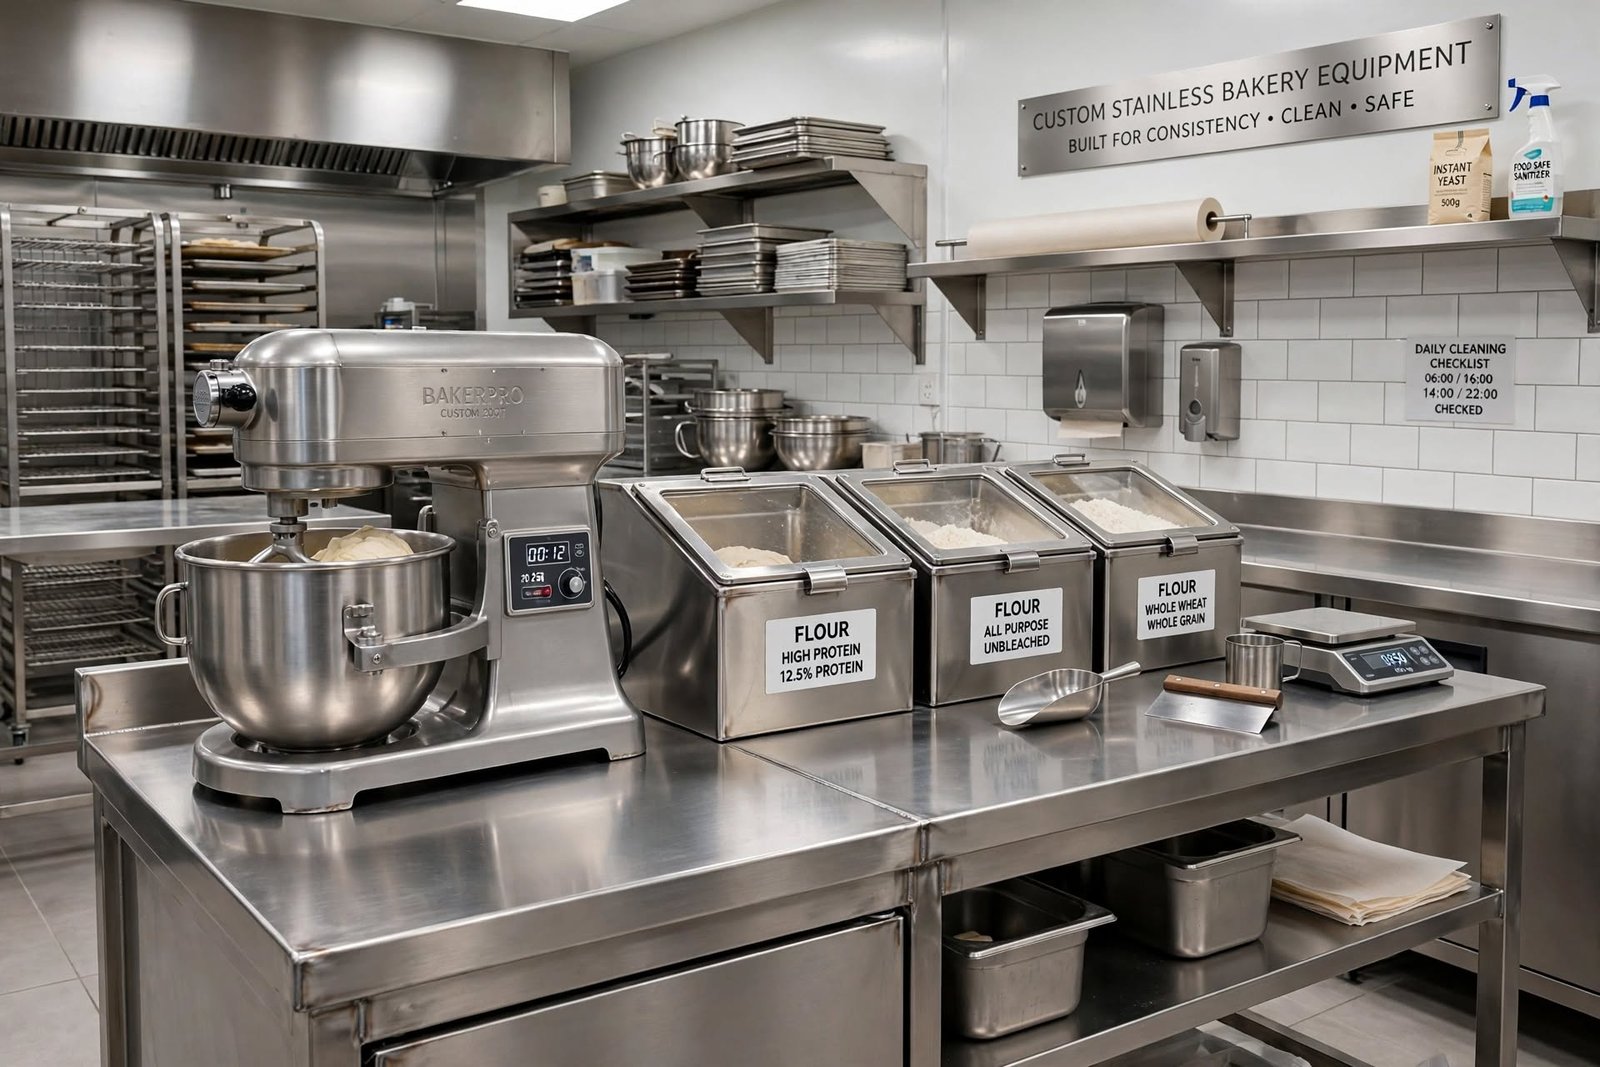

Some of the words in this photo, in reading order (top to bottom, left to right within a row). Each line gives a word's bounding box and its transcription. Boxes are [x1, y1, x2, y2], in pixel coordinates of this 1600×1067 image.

[1033, 102, 1105, 131] CUSTOM
[1112, 84, 1214, 119] STAINLESS
[1222, 68, 1309, 101] BAKERY
[1318, 40, 1472, 87] EQUIPMENT
[1068, 135, 1107, 153] BUILT
[1112, 130, 1141, 147] FOR
[1146, 111, 1261, 142] CONSISTENCY
[1281, 100, 1342, 124] CLEAN
[1365, 90, 1415, 113] SAFE
[1433, 161, 1472, 175] INSTANT
[1513, 161, 1532, 172] FOOD
[1534, 160, 1551, 170] SAFE
[1438, 175, 1467, 187] YEAST
[1513, 170, 1551, 181] SANITIZER
[1441, 198, 1460, 208] 500g
[1415, 343, 1446, 354] DAILY
[1449, 343, 1506, 354] CLEANING
[1430, 358, 1490, 369] CHECKLIST
[1424, 373, 1453, 383] 06:00
[1463, 373, 1493, 384] 16:00
[422, 385, 524, 406] BAKERPRO
[1423, 387, 1454, 398] 14:00
[1465, 388, 1498, 399] 22:00
[440, 408, 480, 418] CUSTOM
[1434, 404, 1483, 415] CHECKED
[528, 545, 566, 562] 00:12
[1158, 579, 1196, 597] FLOUR
[995, 598, 1040, 618] FLOUR
[1145, 601, 1176, 615] WHOLE
[1178, 597, 1207, 611] WHEAT
[984, 624, 1002, 638] ALL
[1004, 618, 1049, 635] PURPOSE
[1147, 616, 1177, 630] WHOLE
[1179, 612, 1205, 626] GRAIN
[795, 620, 849, 643] FLOUR
[984, 634, 1050, 654] UNBLEACHED
[782, 649, 811, 665] HIGH
[813, 643, 861, 660] PROTEIN
[780, 666, 813, 683] 12.5%
[815, 660, 863, 678] PROTEIN
